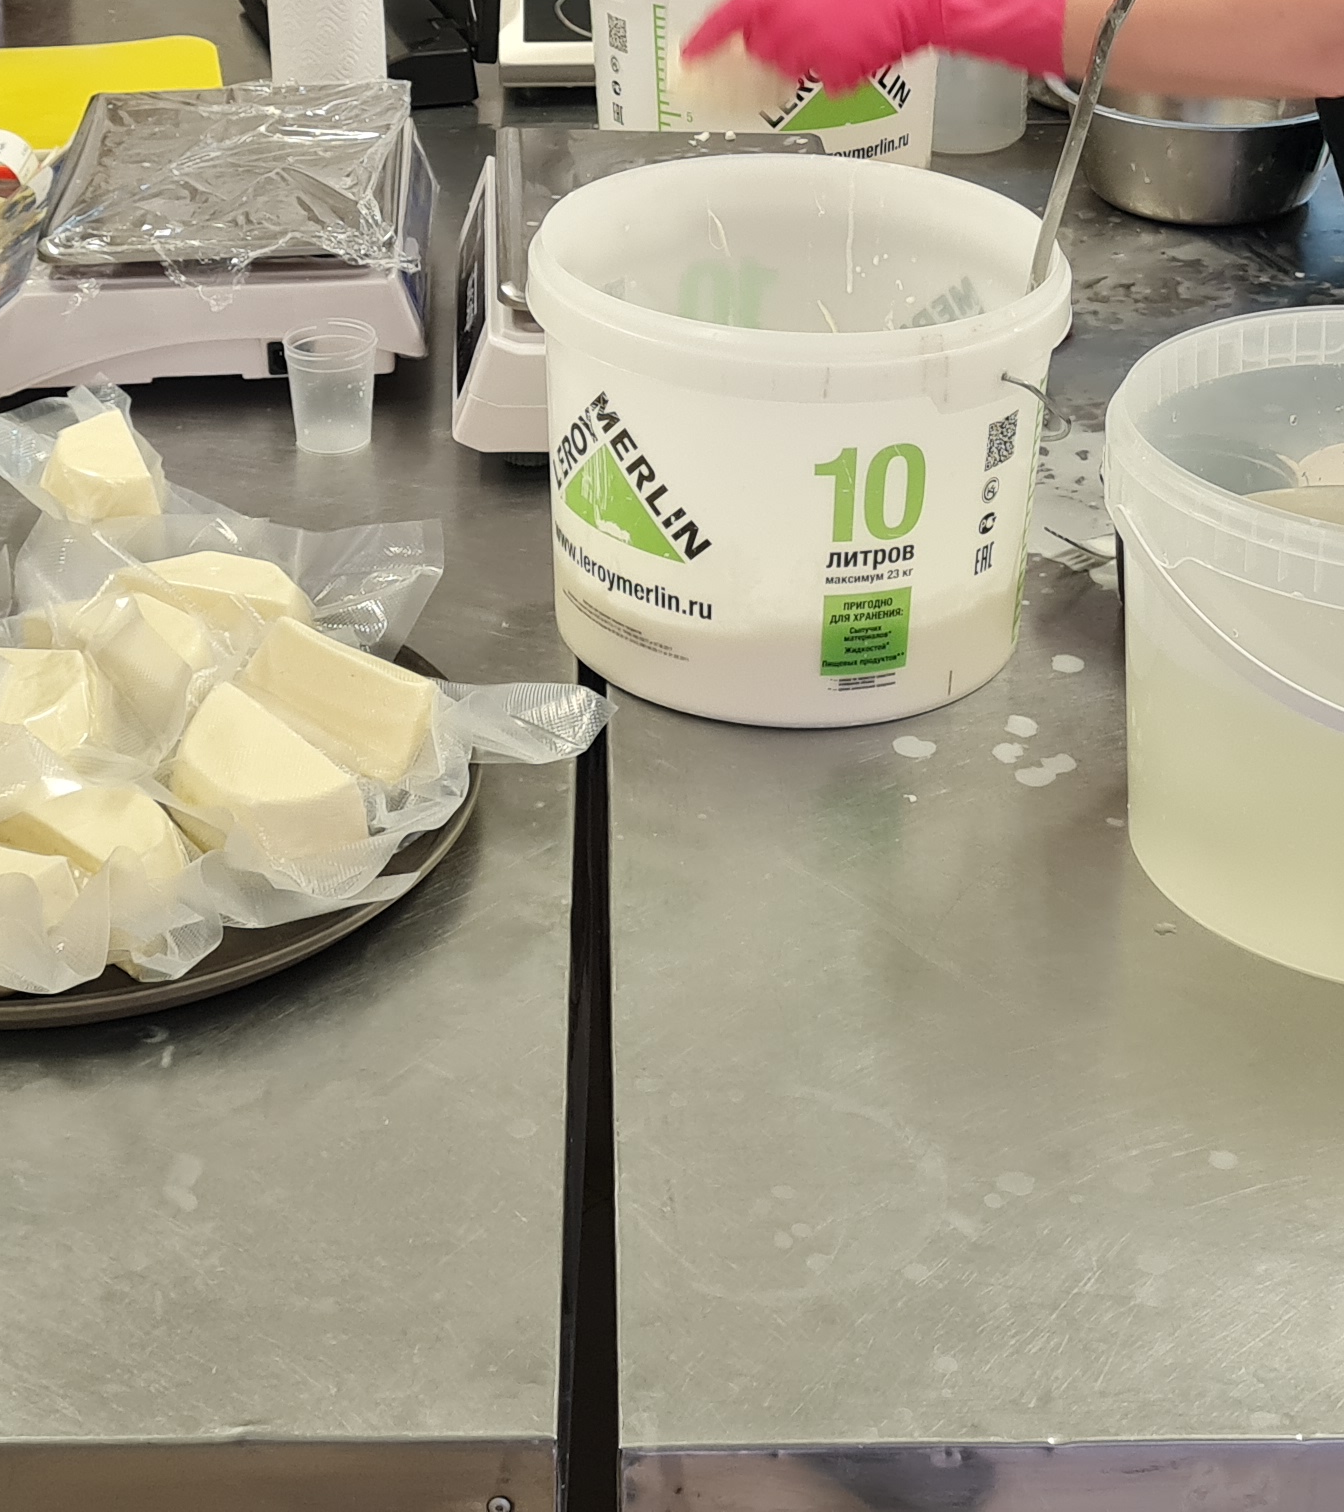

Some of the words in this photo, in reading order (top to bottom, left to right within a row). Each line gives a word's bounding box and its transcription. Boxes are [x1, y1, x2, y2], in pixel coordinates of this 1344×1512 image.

[686, 112, 693, 122] 5
[553, 406, 598, 491] LEROY
[590, 391, 712, 560] MERLIN
[814, 443, 926, 542] 10
[826, 544, 915, 570] литров
[554, 520, 712, 621] www.leroymerlin.ru
[825, 573, 884, 584] максимум
[887, 568, 899, 580] 23
[902, 568, 914, 578] кг
[843, 597, 893, 611] ПРИГОДНО
[829, 613, 850, 625] ДЛЯ
[853, 608, 904, 623] ХРАНЕНИЯ:
